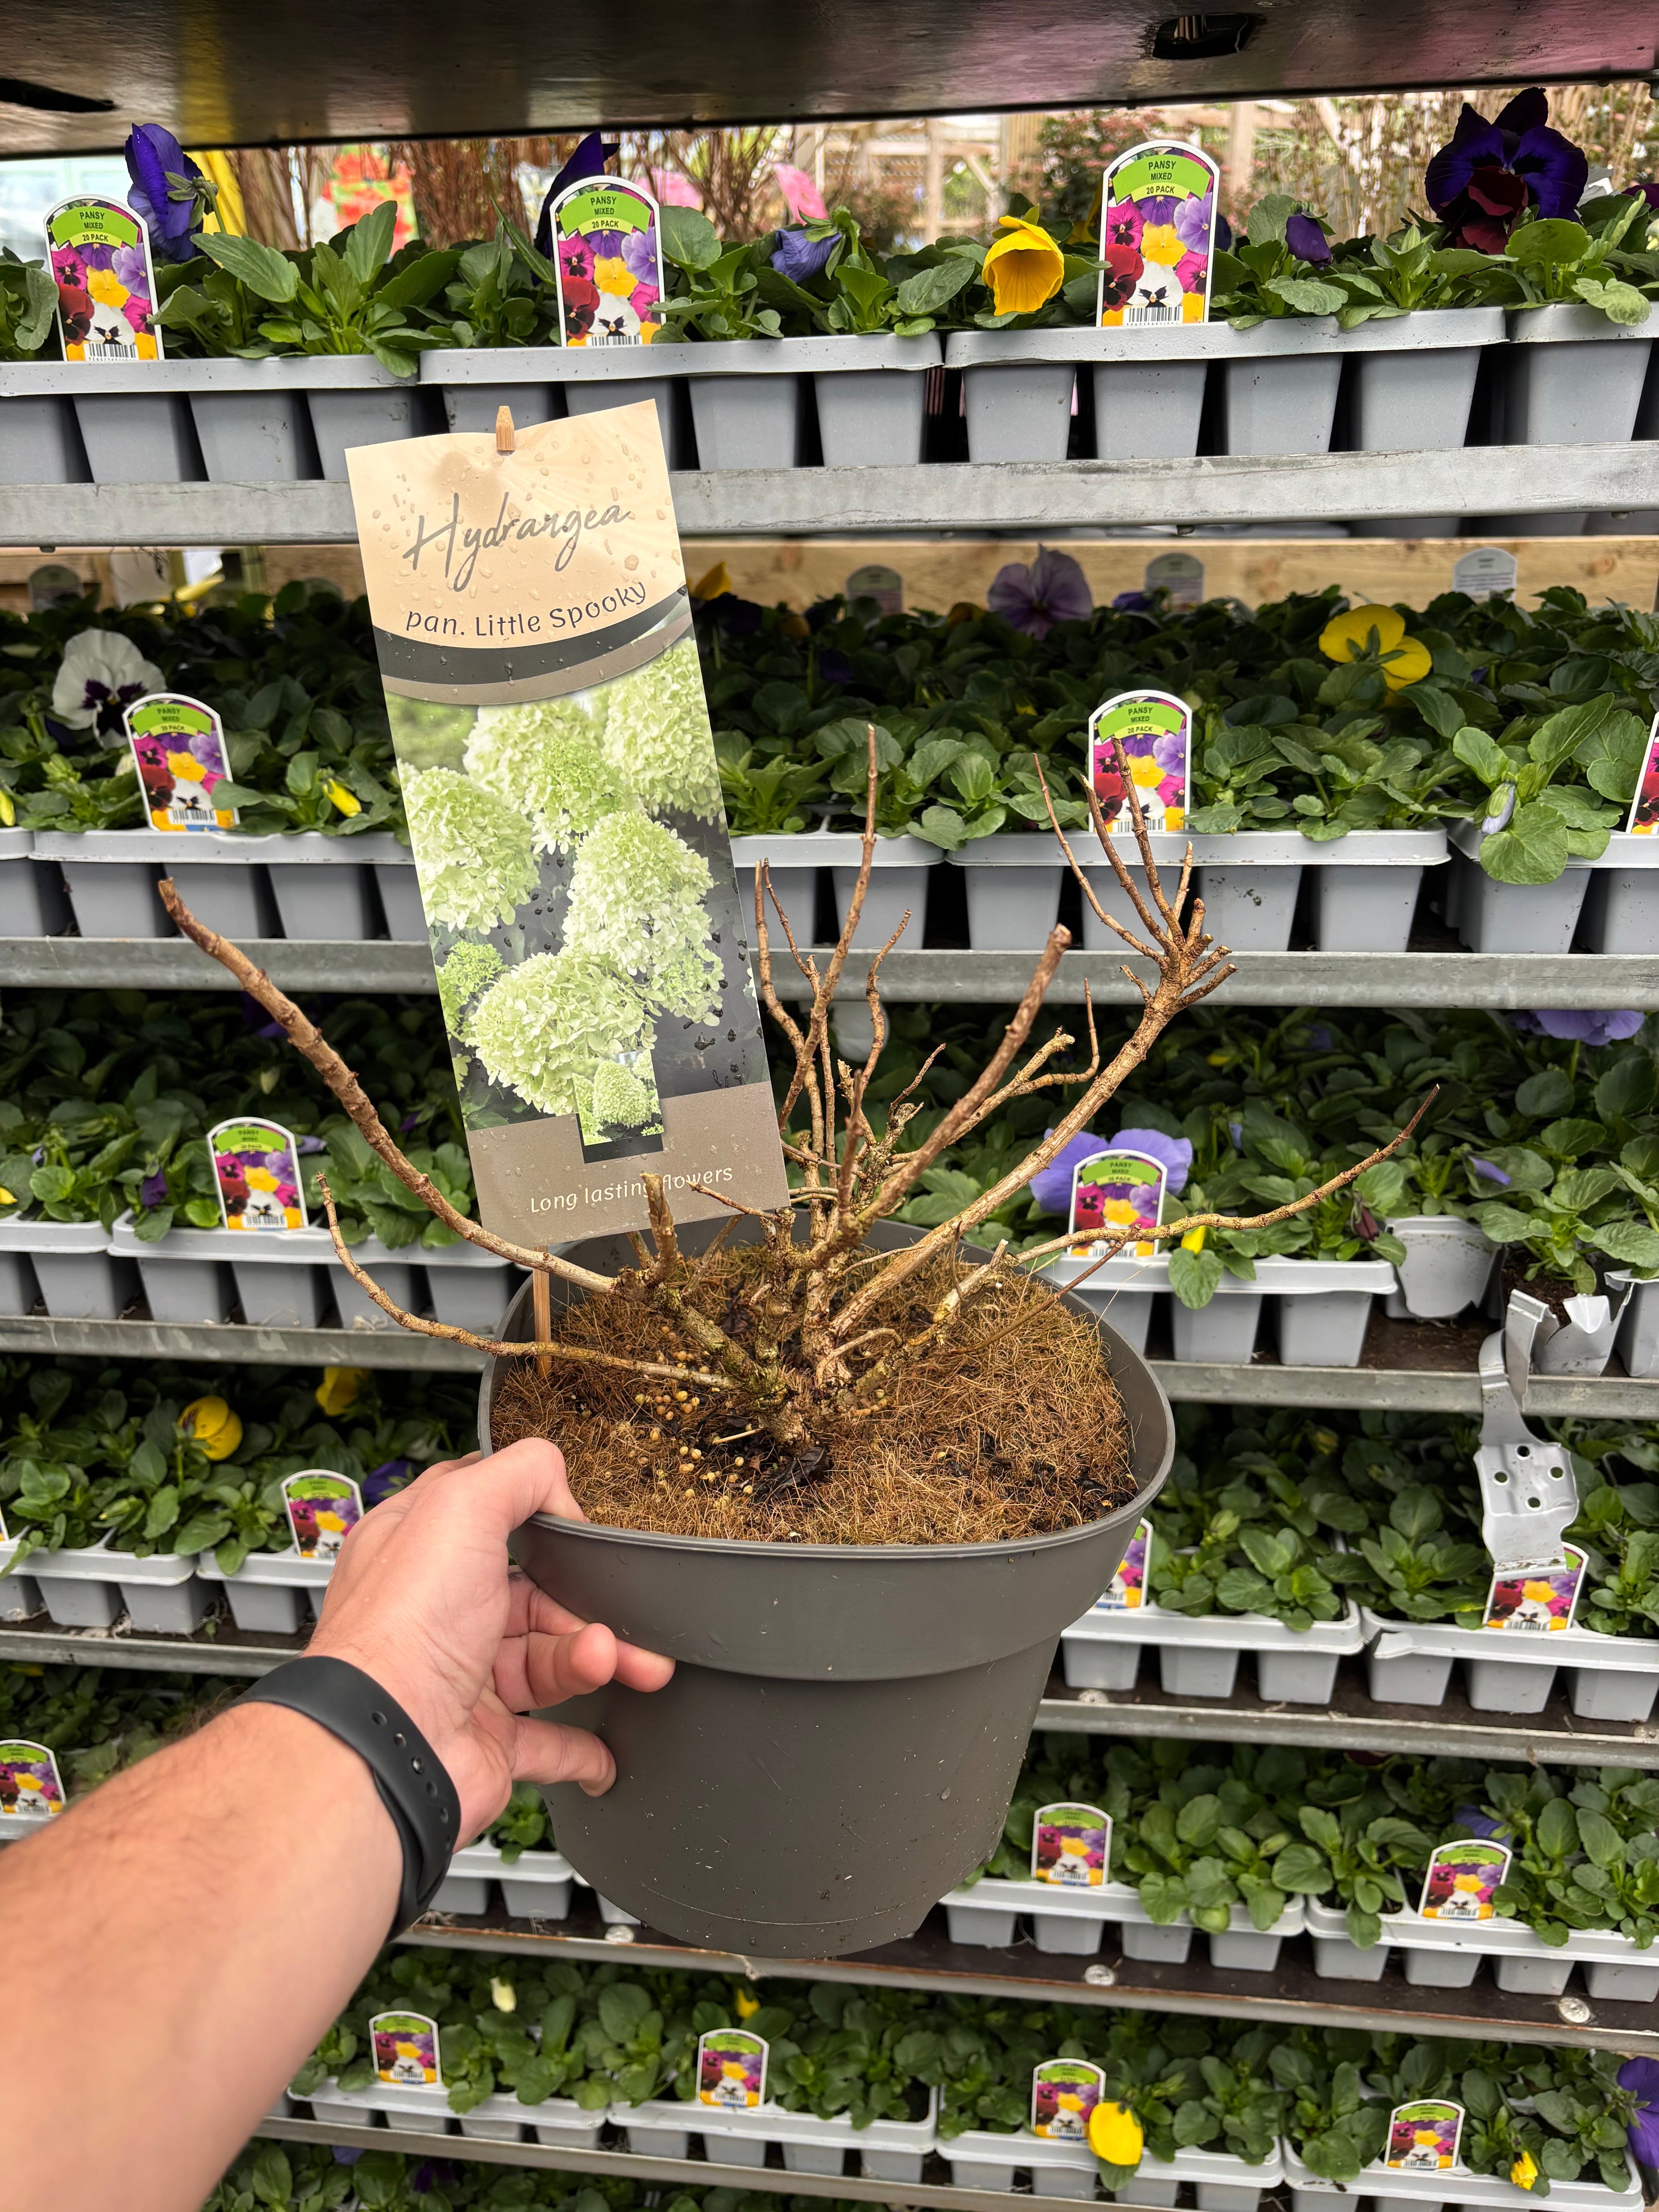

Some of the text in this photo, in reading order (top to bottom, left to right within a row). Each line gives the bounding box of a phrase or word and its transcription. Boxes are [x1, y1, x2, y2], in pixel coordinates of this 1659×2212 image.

[1148, 160, 1176, 170] PANSY
[1151, 172, 1172, 181] MIXED
[1146, 186, 1154, 194] 20
[590, 196, 617, 206] PANSY
[79, 211, 105, 220] PANSY
[402, 492, 631, 592] Hydrangea
[406, 582, 646, 636] pan. Little Spooky
[531, 1193, 577, 1213] Long
